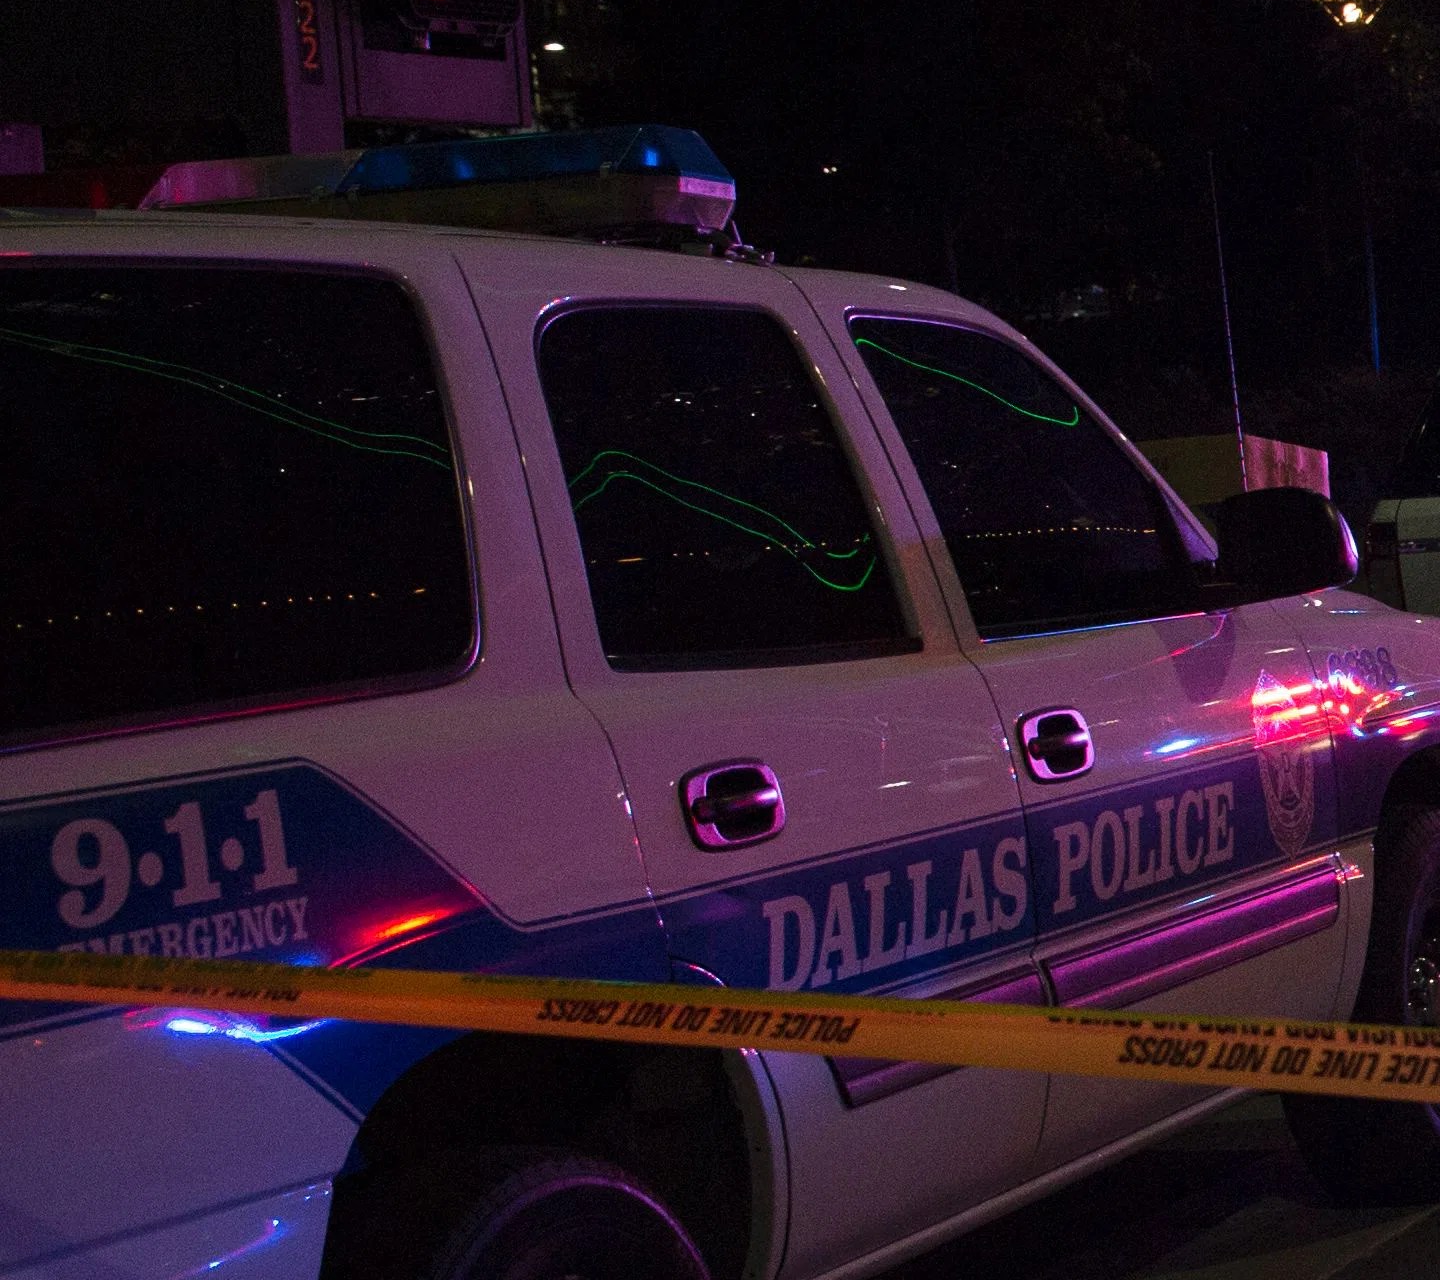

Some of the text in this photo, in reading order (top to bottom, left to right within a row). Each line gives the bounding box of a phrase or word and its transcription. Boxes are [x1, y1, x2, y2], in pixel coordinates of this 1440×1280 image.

[763, 781, 1236, 993] DALLAS POLICE
[537, 998, 860, 1043] POLICE LINE DO NOT CROSS
[1118, 1035, 1207, 1068] CROSS
[1207, 1042, 1268, 1072] NOT
[1271, 1046, 1312, 1075] DO
[1313, 1050, 1380, 1081] LINE
